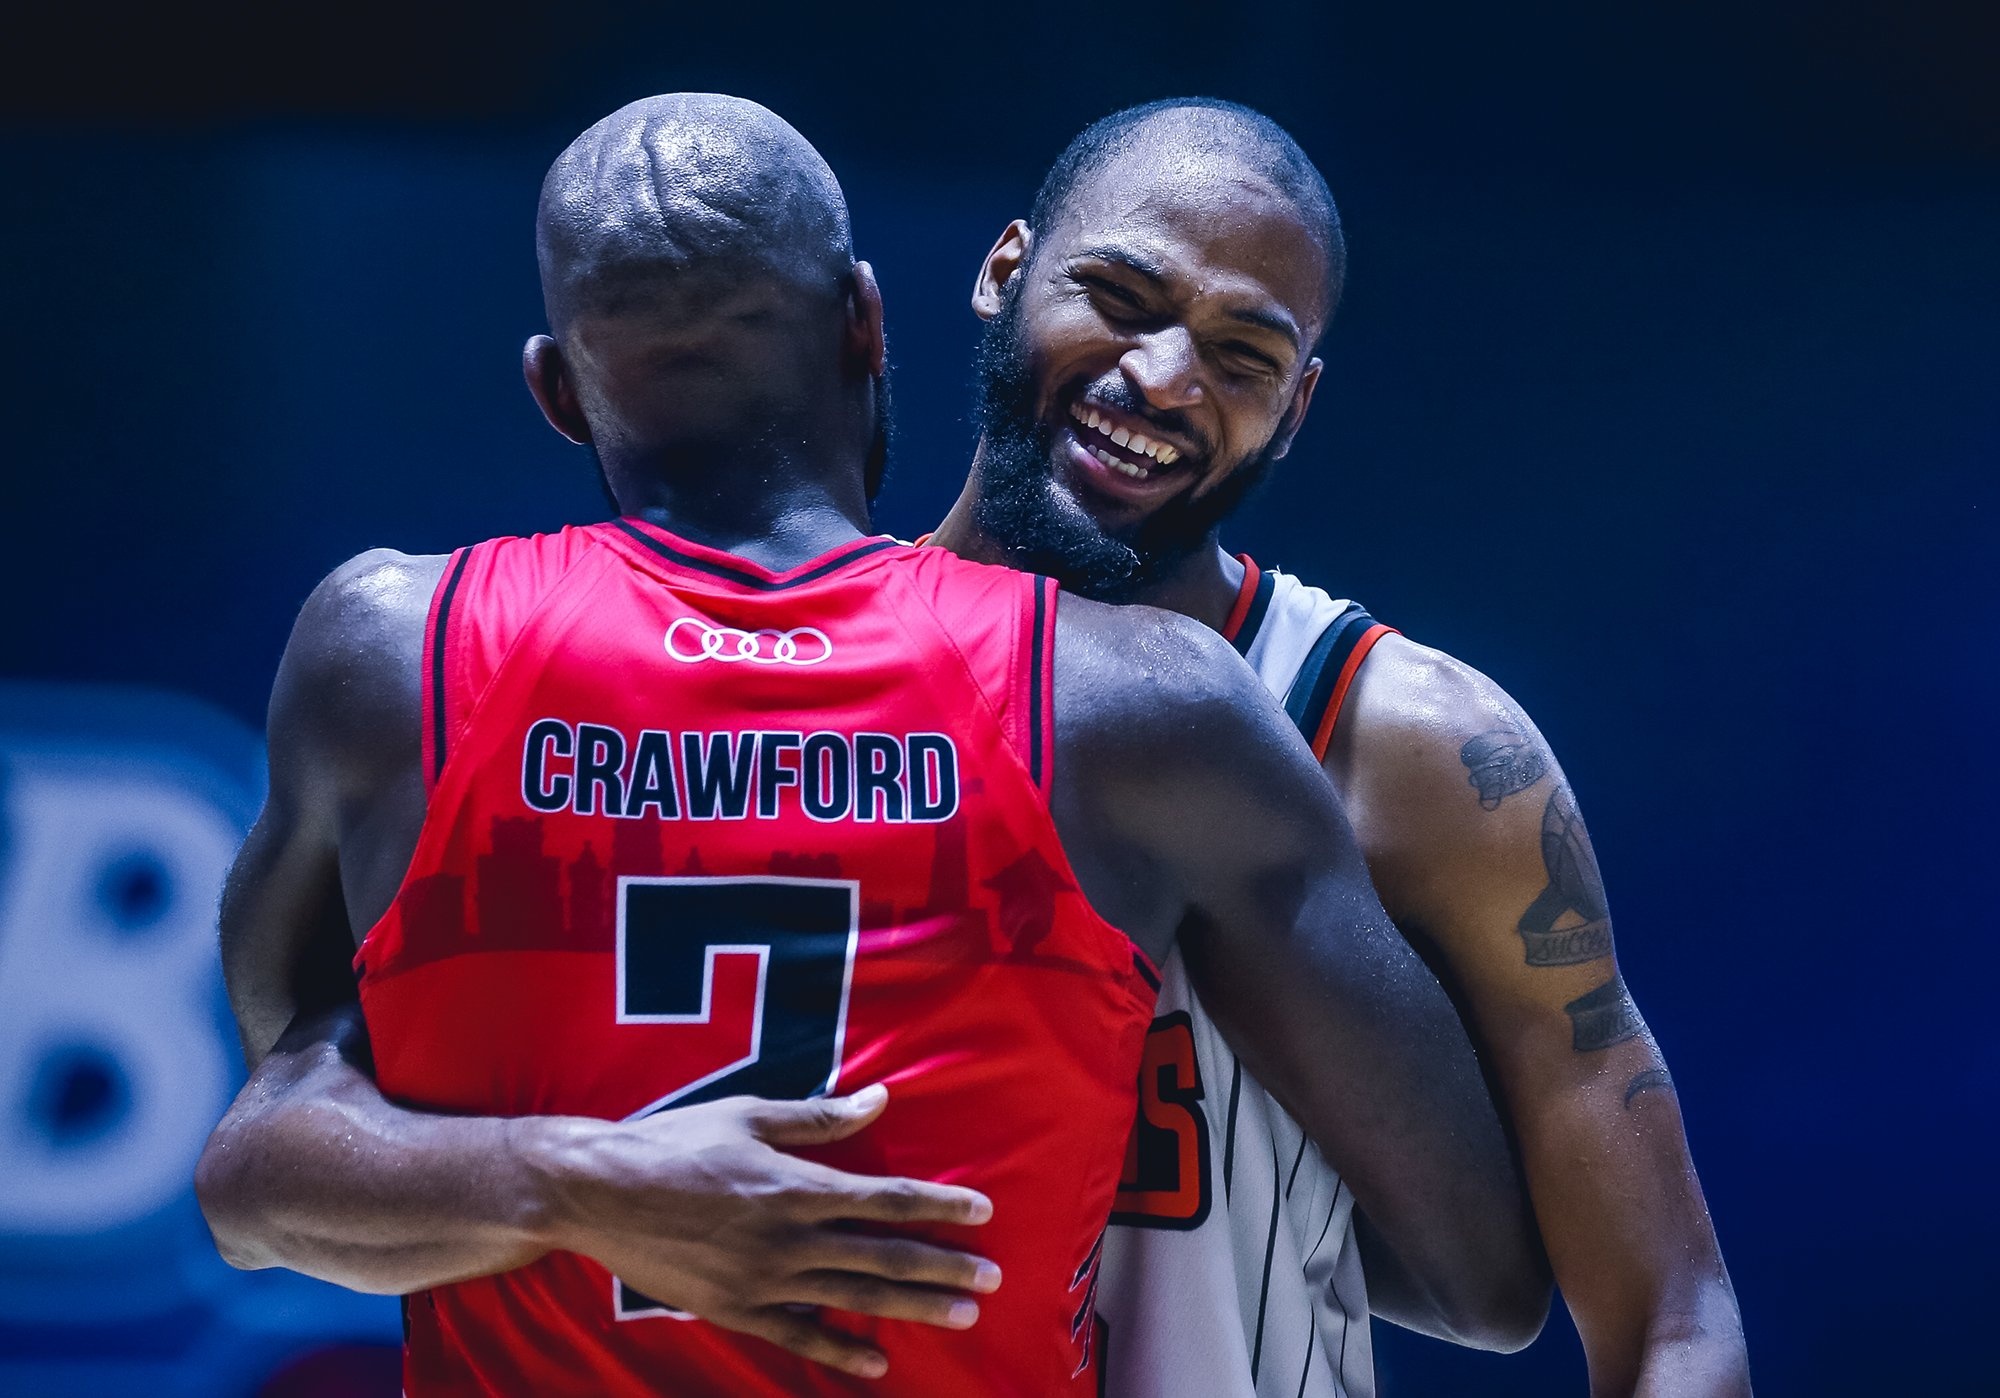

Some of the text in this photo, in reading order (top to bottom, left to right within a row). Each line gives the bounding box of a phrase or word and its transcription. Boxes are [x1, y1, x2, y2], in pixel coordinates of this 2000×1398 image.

[0, 752, 235, 1234] B
[522, 718, 960, 824] CRAWFORD
[614, 874, 861, 1322] 2
